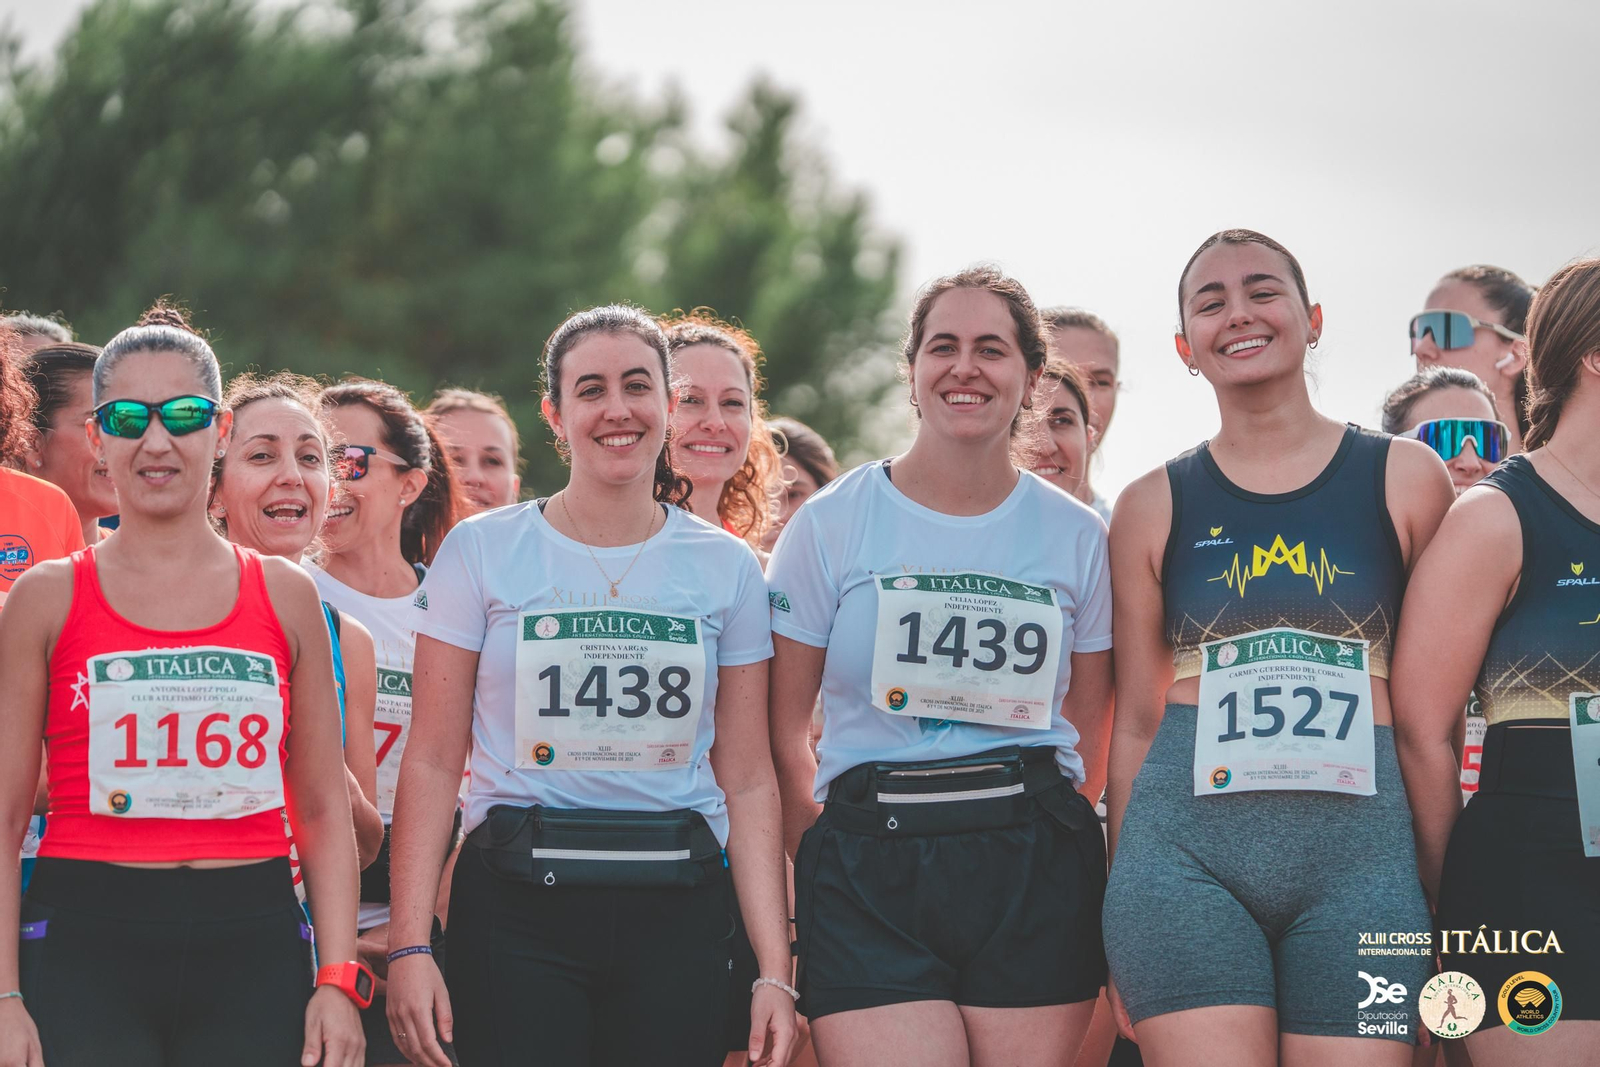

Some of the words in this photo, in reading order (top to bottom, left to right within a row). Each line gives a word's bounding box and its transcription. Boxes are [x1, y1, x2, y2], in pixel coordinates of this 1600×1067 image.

[1193, 538, 1234, 548] SPALL
[930, 576, 1012, 595] ITÁLICA
[1556, 577, 1600, 586] SPALL
[944, 602, 1004, 614] INDEPENDIENTE
[950, 596, 972, 604] CELIA
[974, 597, 998, 606] LÓPEZ
[572, 613, 654, 636] ITÁLICA
[896, 612, 1048, 675] 1439
[1250, 634, 1325, 659] ITÁLICA
[147, 656, 236, 675] ITÁLICA
[1229, 668, 1258, 679] CARMEN
[1318, 669, 1346, 679] CORRAL
[538, 665, 692, 718] 1438
[1218, 686, 1359, 743] 1527
[114, 713, 269, 769] 1168
